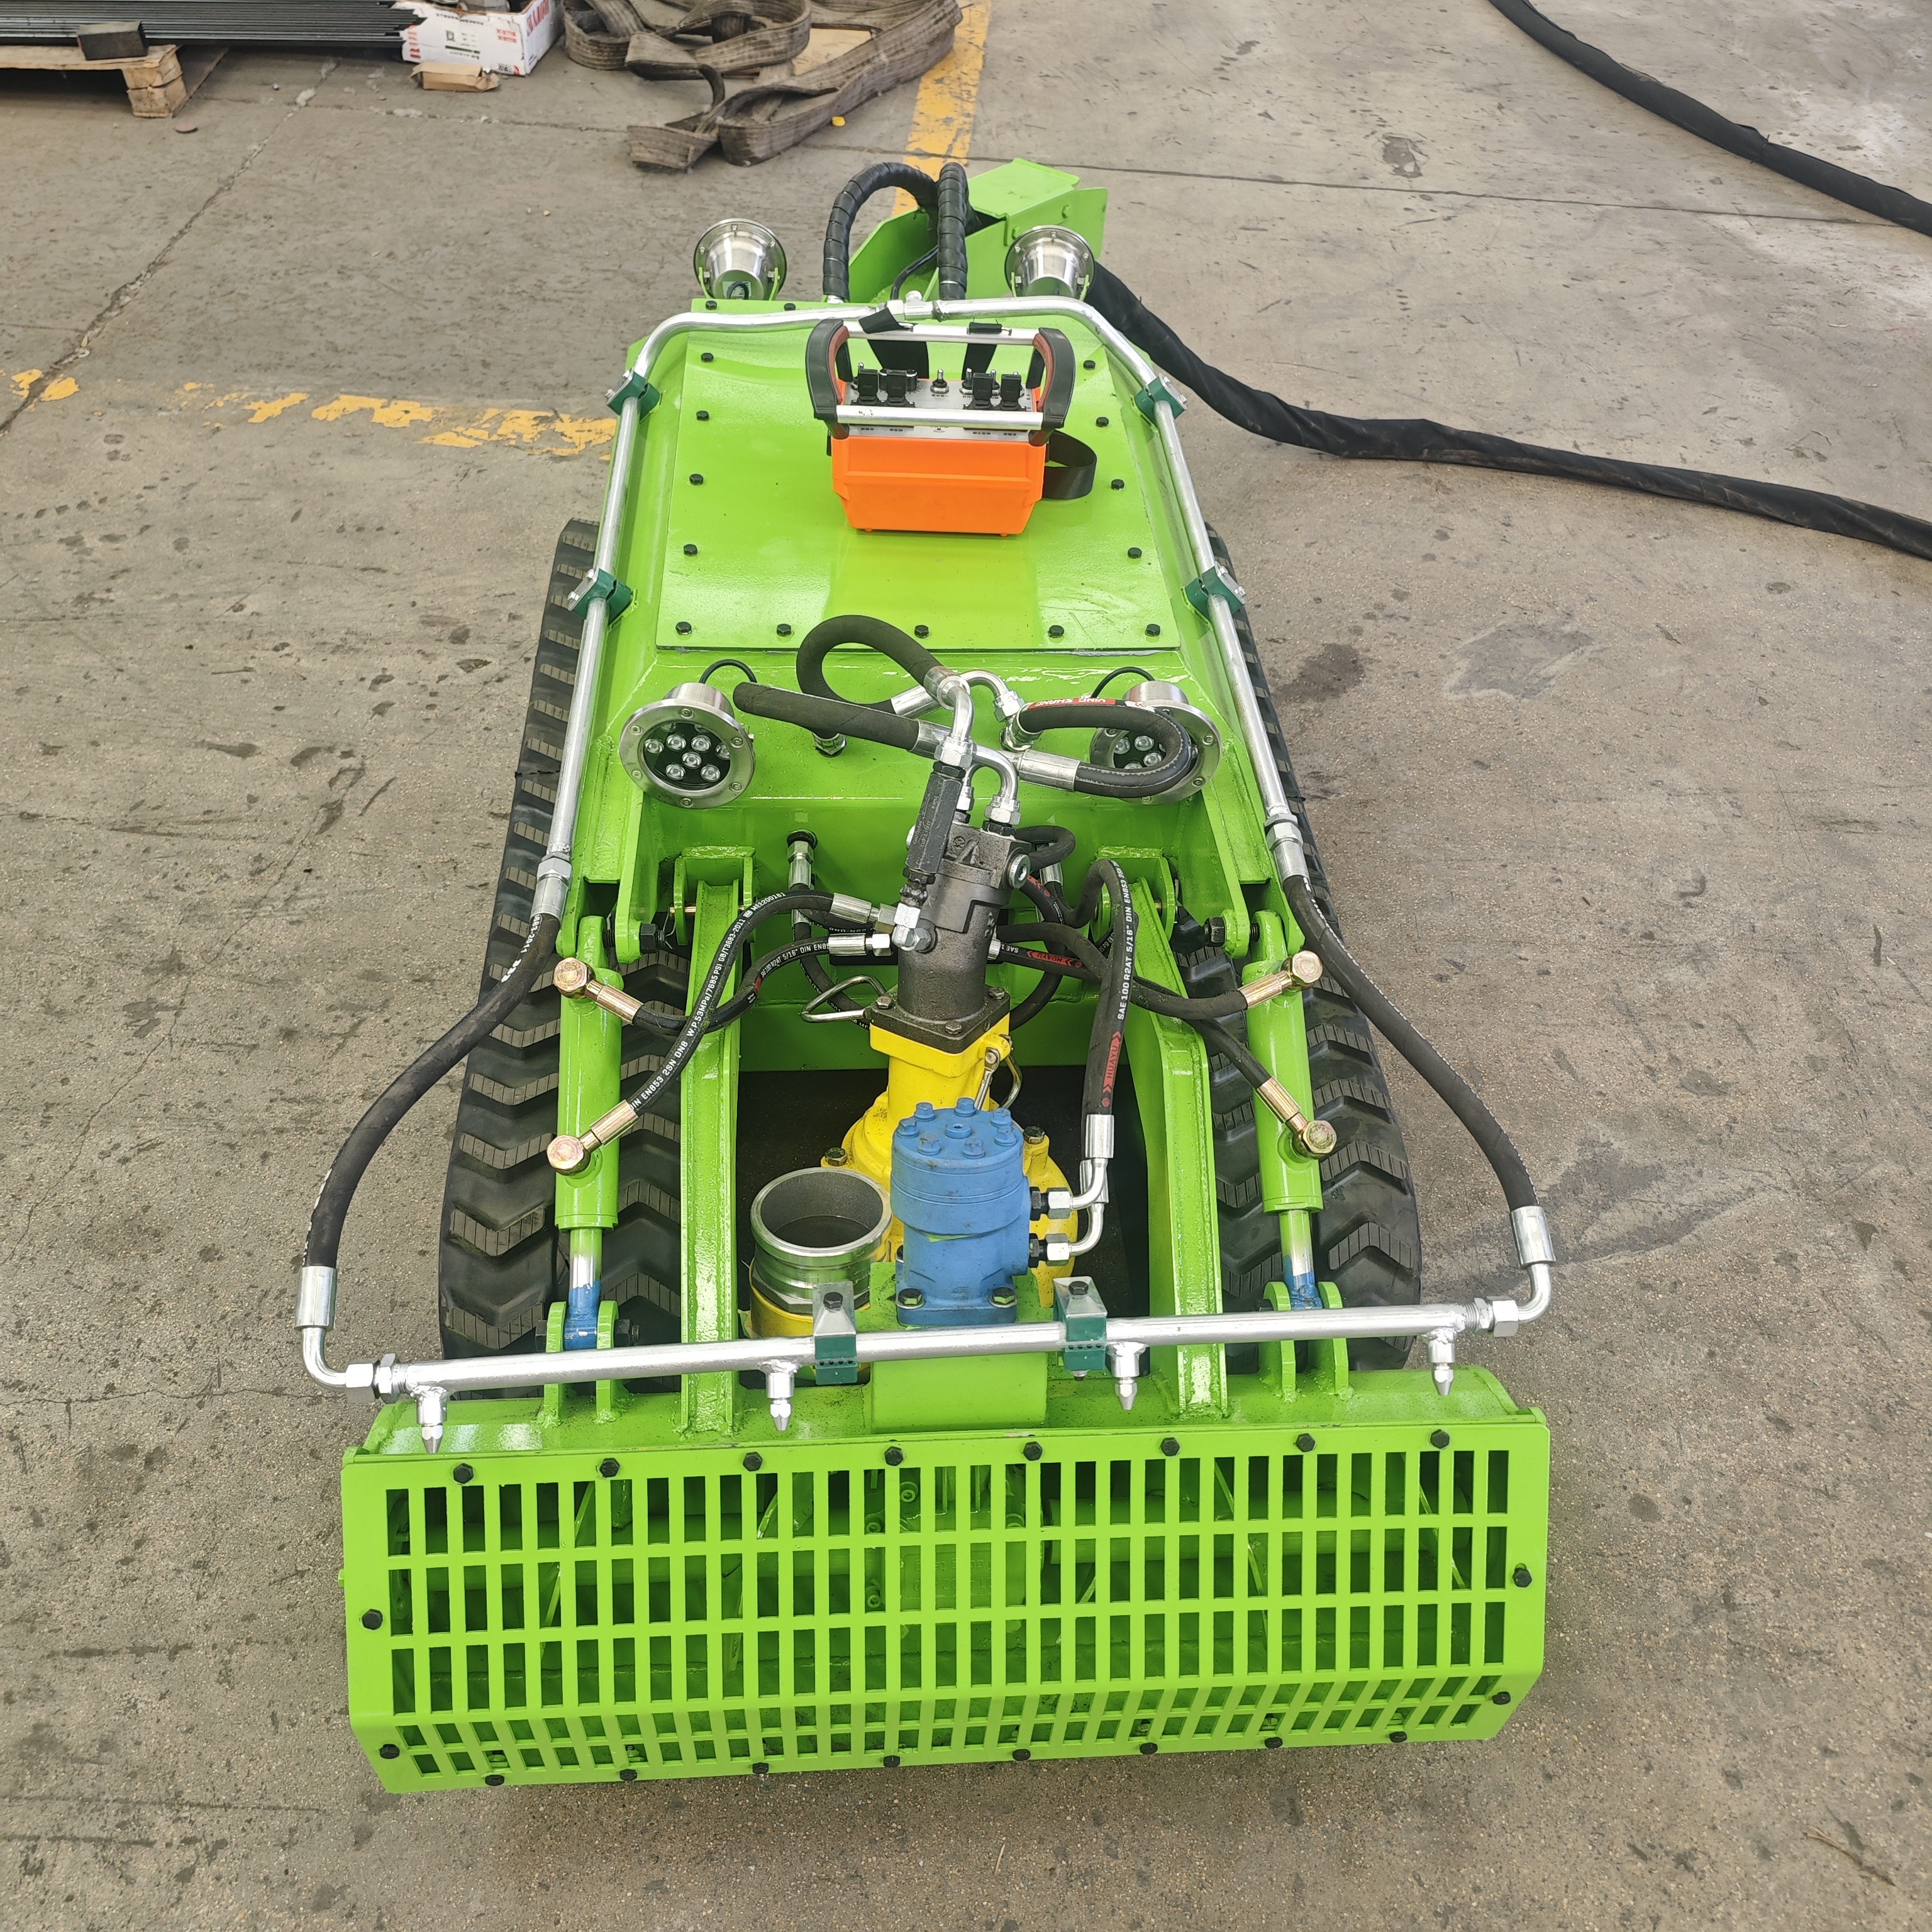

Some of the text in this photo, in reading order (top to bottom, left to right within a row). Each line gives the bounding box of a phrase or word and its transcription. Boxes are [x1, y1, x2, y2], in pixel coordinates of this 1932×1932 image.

[1124, 906, 1133, 923] DIN
[770, 956, 782, 969] R2AT
[782, 948, 798, 961] 5/16"
[799, 945, 811, 954] DIN
[1036, 953, 1063, 963] HUAYU
[1123, 956, 1132, 980] R2AT
[1121, 982, 1130, 1001] 100
[1117, 1002, 1126, 1019] SAE
[640, 1075, 664, 1100] EN853
[662, 1058, 677, 1076] 2SN
[674, 1040, 688, 1058] DN8
[1106, 1045, 1118, 1079] HUAYU
